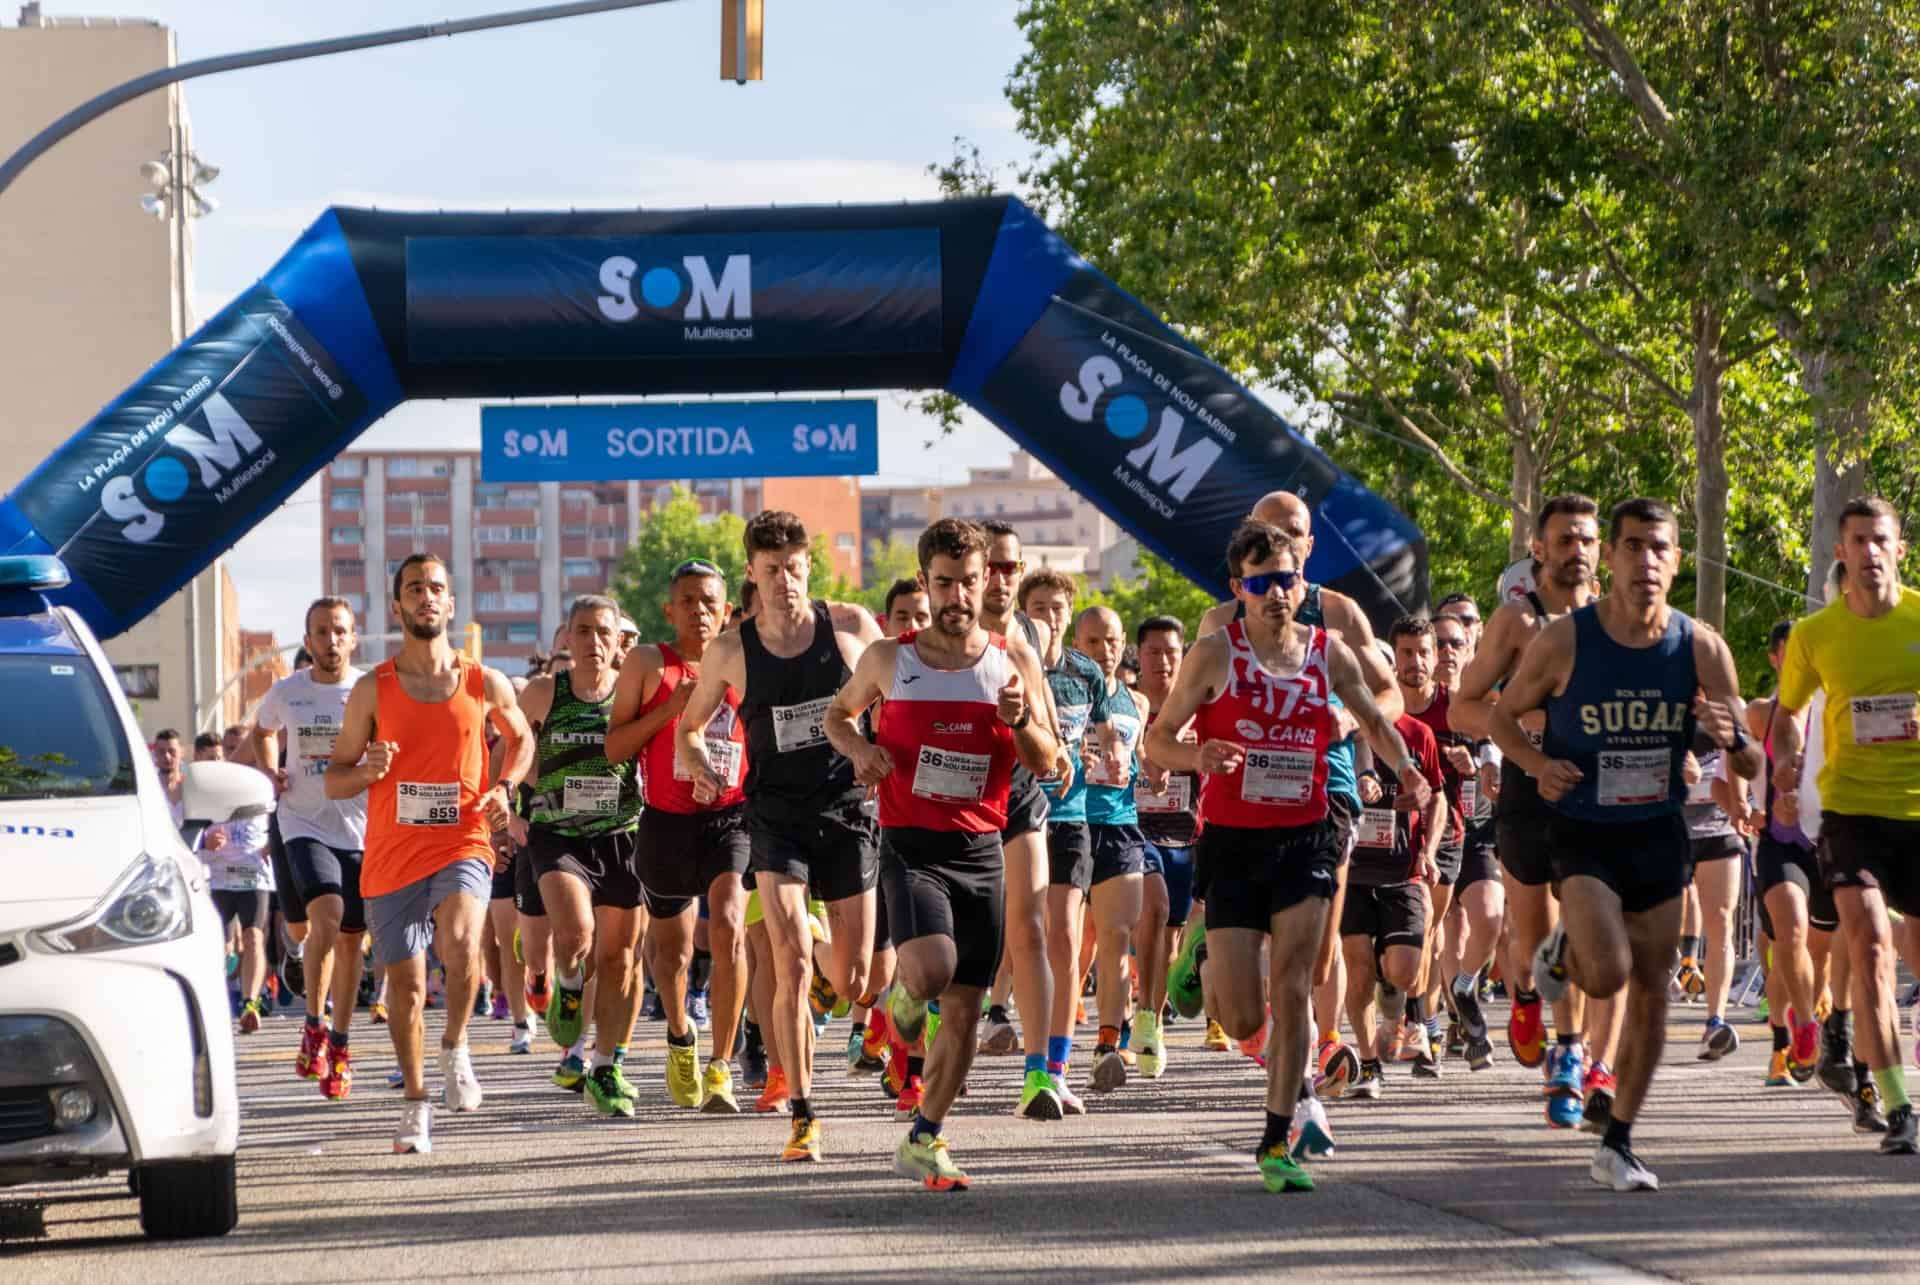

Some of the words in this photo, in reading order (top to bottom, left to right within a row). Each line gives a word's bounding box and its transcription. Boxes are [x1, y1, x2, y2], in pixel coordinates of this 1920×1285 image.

[597, 254, 753, 322] SOM
[684, 325, 753, 341] Multiespai
[1101, 330, 1117, 349] LA
[1153, 373, 1171, 392] DE
[1169, 385, 1198, 413] NOU
[1196, 407, 1237, 442] BARRIS
[77, 474, 96, 492] LA
[94, 442, 131, 480] PLAÇA
[131, 427, 149, 448] DE
[146, 407, 174, 438] NOU
[171, 375, 212, 411] BARRIS
[1059, 355, 1223, 502] SOM
[503, 429, 568, 458] SOM
[606, 426, 754, 458] SORTIDA
[793, 423, 857, 452] SOM
[101, 390, 263, 543] SOM
[214, 447, 277, 504] Multiespai
[1112, 464, 1177, 520] Multiespai
[775, 709, 794, 721] 36
[1852, 700, 1873, 713] 36
[919, 750, 943, 767] 36
[1247, 753, 1270, 769] 36
[1601, 756, 1625, 769] 36
[399, 784, 418, 796] 36
[566, 779, 582, 790] 36
[1300, 784, 1310, 798] 2
[429, 806, 458, 819] 859
[594, 800, 617, 810] 155
